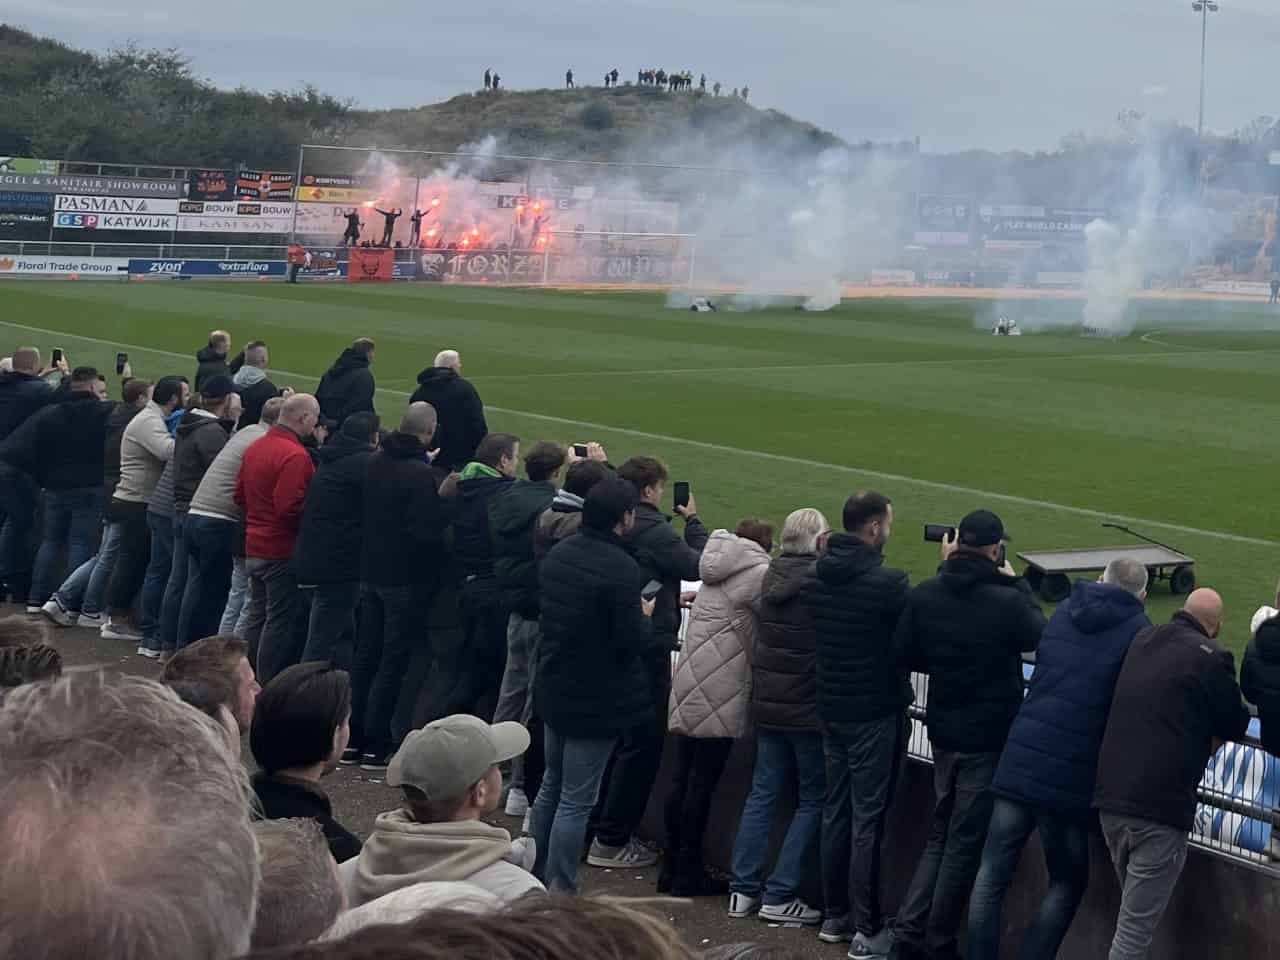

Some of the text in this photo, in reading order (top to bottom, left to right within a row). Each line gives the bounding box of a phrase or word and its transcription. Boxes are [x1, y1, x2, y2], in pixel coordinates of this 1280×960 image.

[106, 179, 177, 192] SHOWROOM
[58, 197, 134, 212] PASMAN
[205, 204, 236, 213] BOUW
[262, 206, 292, 214] BOUW
[103, 217, 170, 229] KATWIJK
[17, 261, 113, 273] Floral Trade Group
